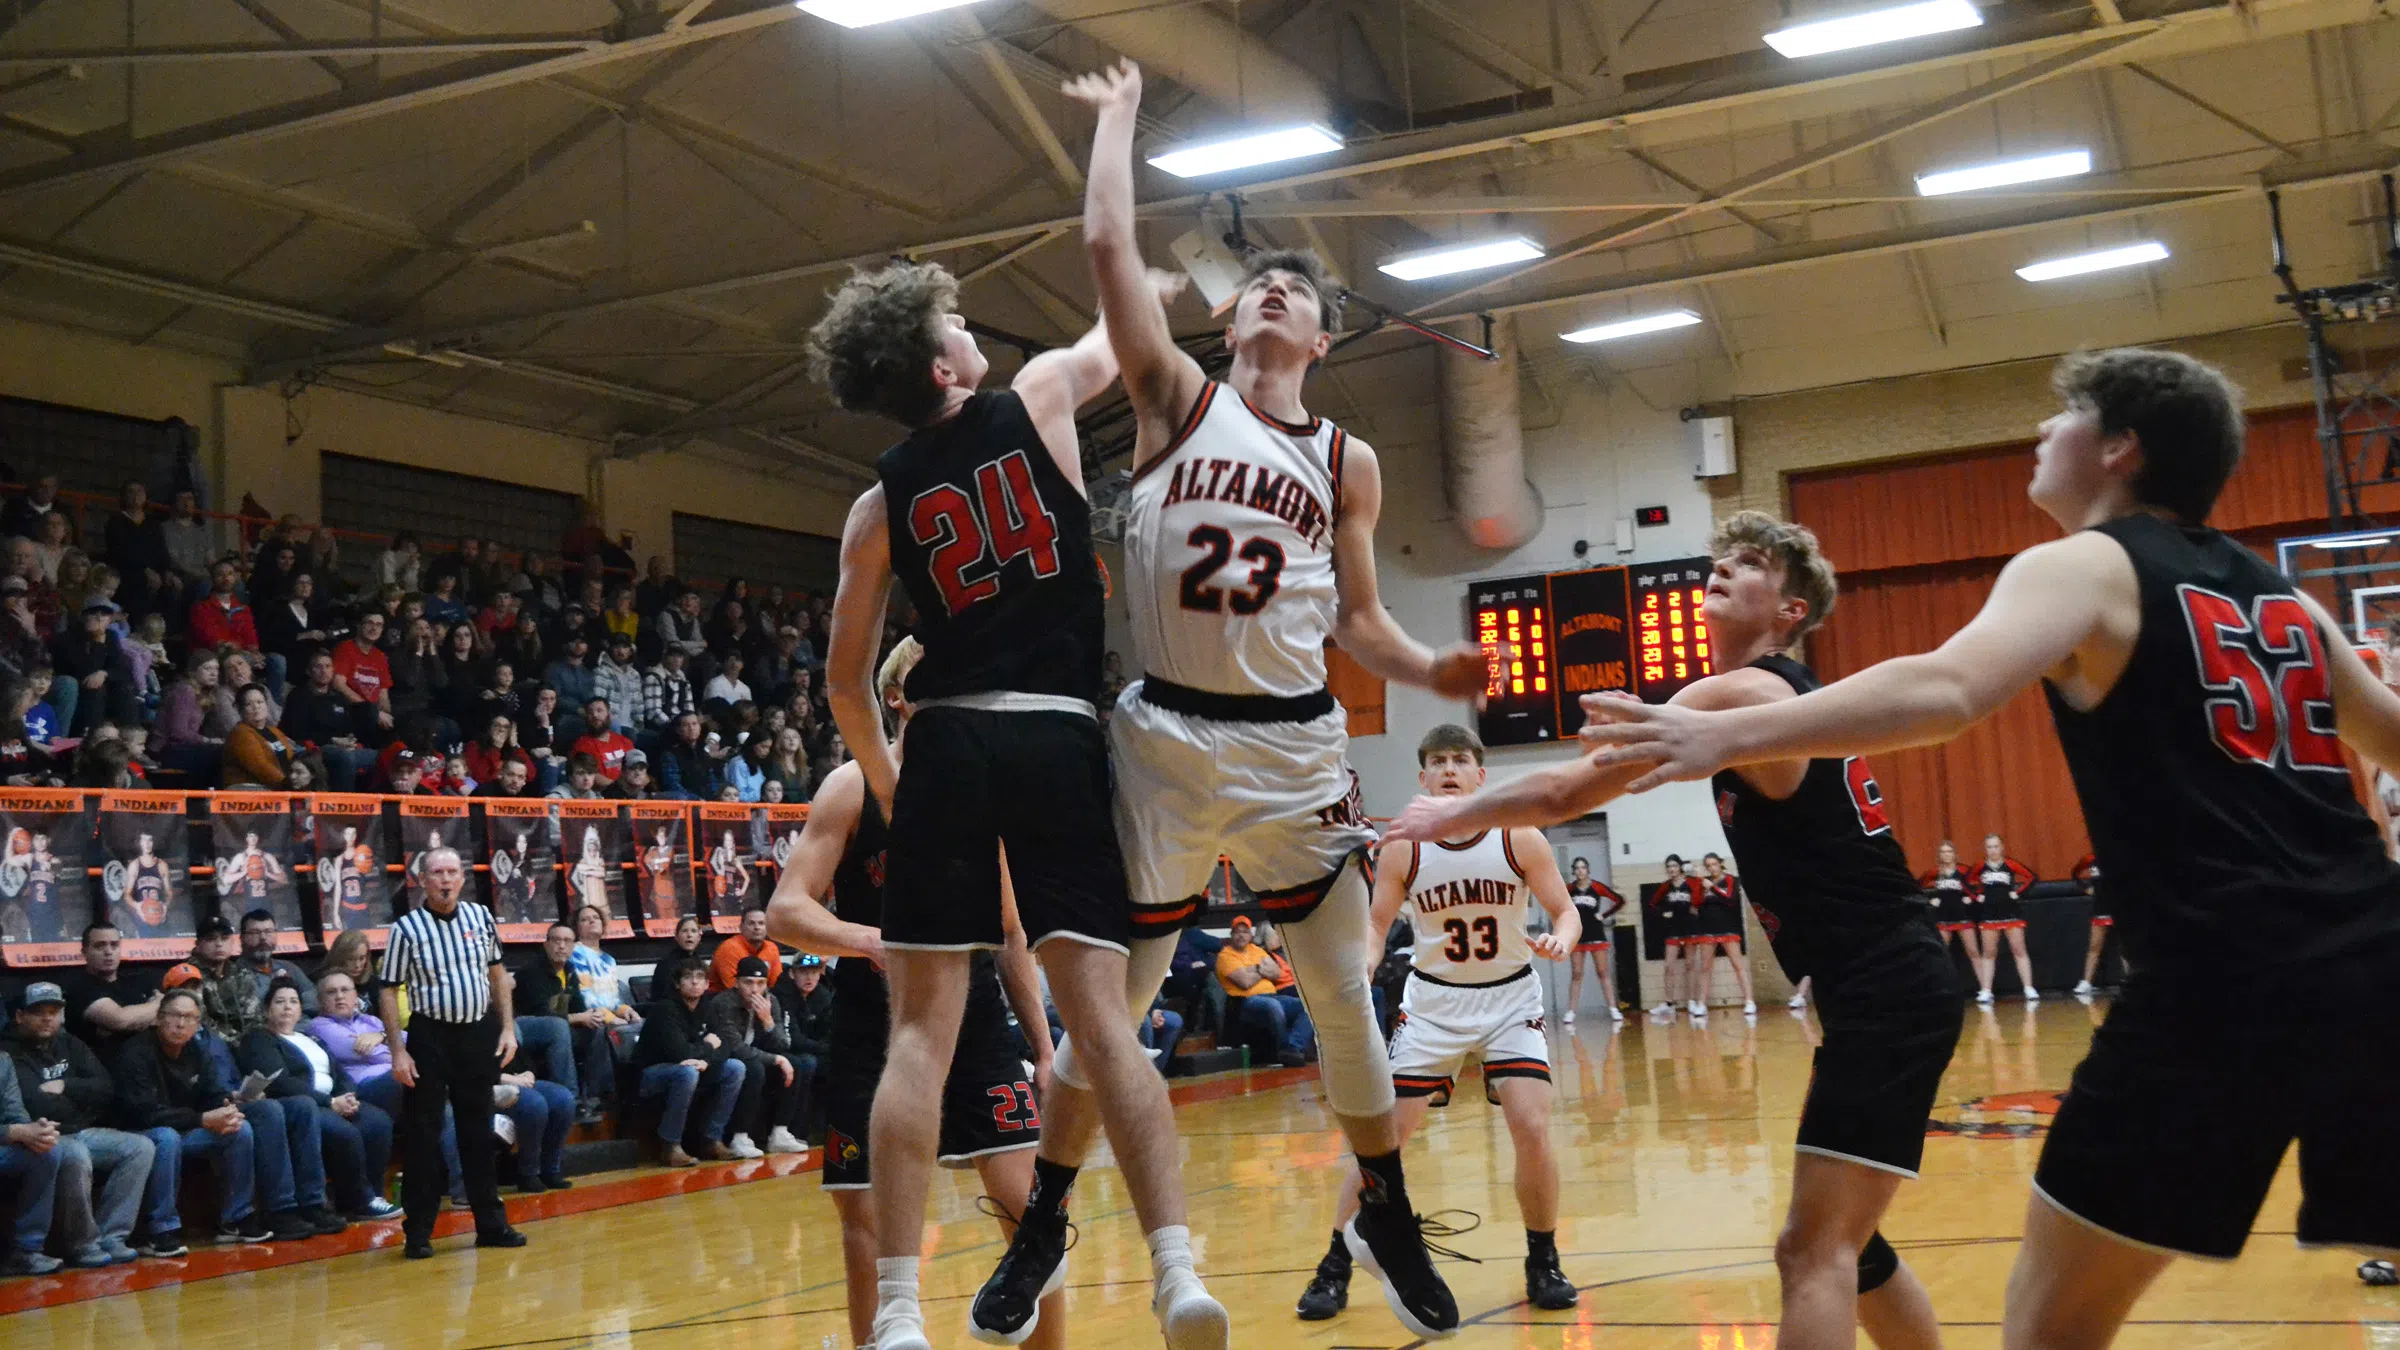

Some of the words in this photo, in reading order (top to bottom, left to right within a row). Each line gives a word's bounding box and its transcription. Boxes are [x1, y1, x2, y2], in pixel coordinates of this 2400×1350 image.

[1161, 459, 1327, 553] ALTAMONT
[908, 449, 1060, 616] 24
[1180, 523, 1287, 616] 23
[1646, 594, 1657, 608] 2
[1669, 592, 1681, 607] 2
[1564, 661, 1626, 691] INDIANS
[2177, 583, 2352, 772] 52
[1, 798, 75, 810] INDIANS
[113, 798, 178, 812] INDIANS
[219, 801, 282, 813] INDIANS
[318, 802, 375, 813] INDIANS
[408, 804, 463, 816] INDIANS
[493, 805, 543, 816] INDIANS
[565, 807, 613, 816] INDIANS
[706, 810, 747, 819] INDIANS
[772, 811, 808, 819] INDIAN
[1417, 878, 1516, 913] ALTAMONT
[1443, 915, 1499, 962] 33
[986, 1080, 1040, 1133] 23
